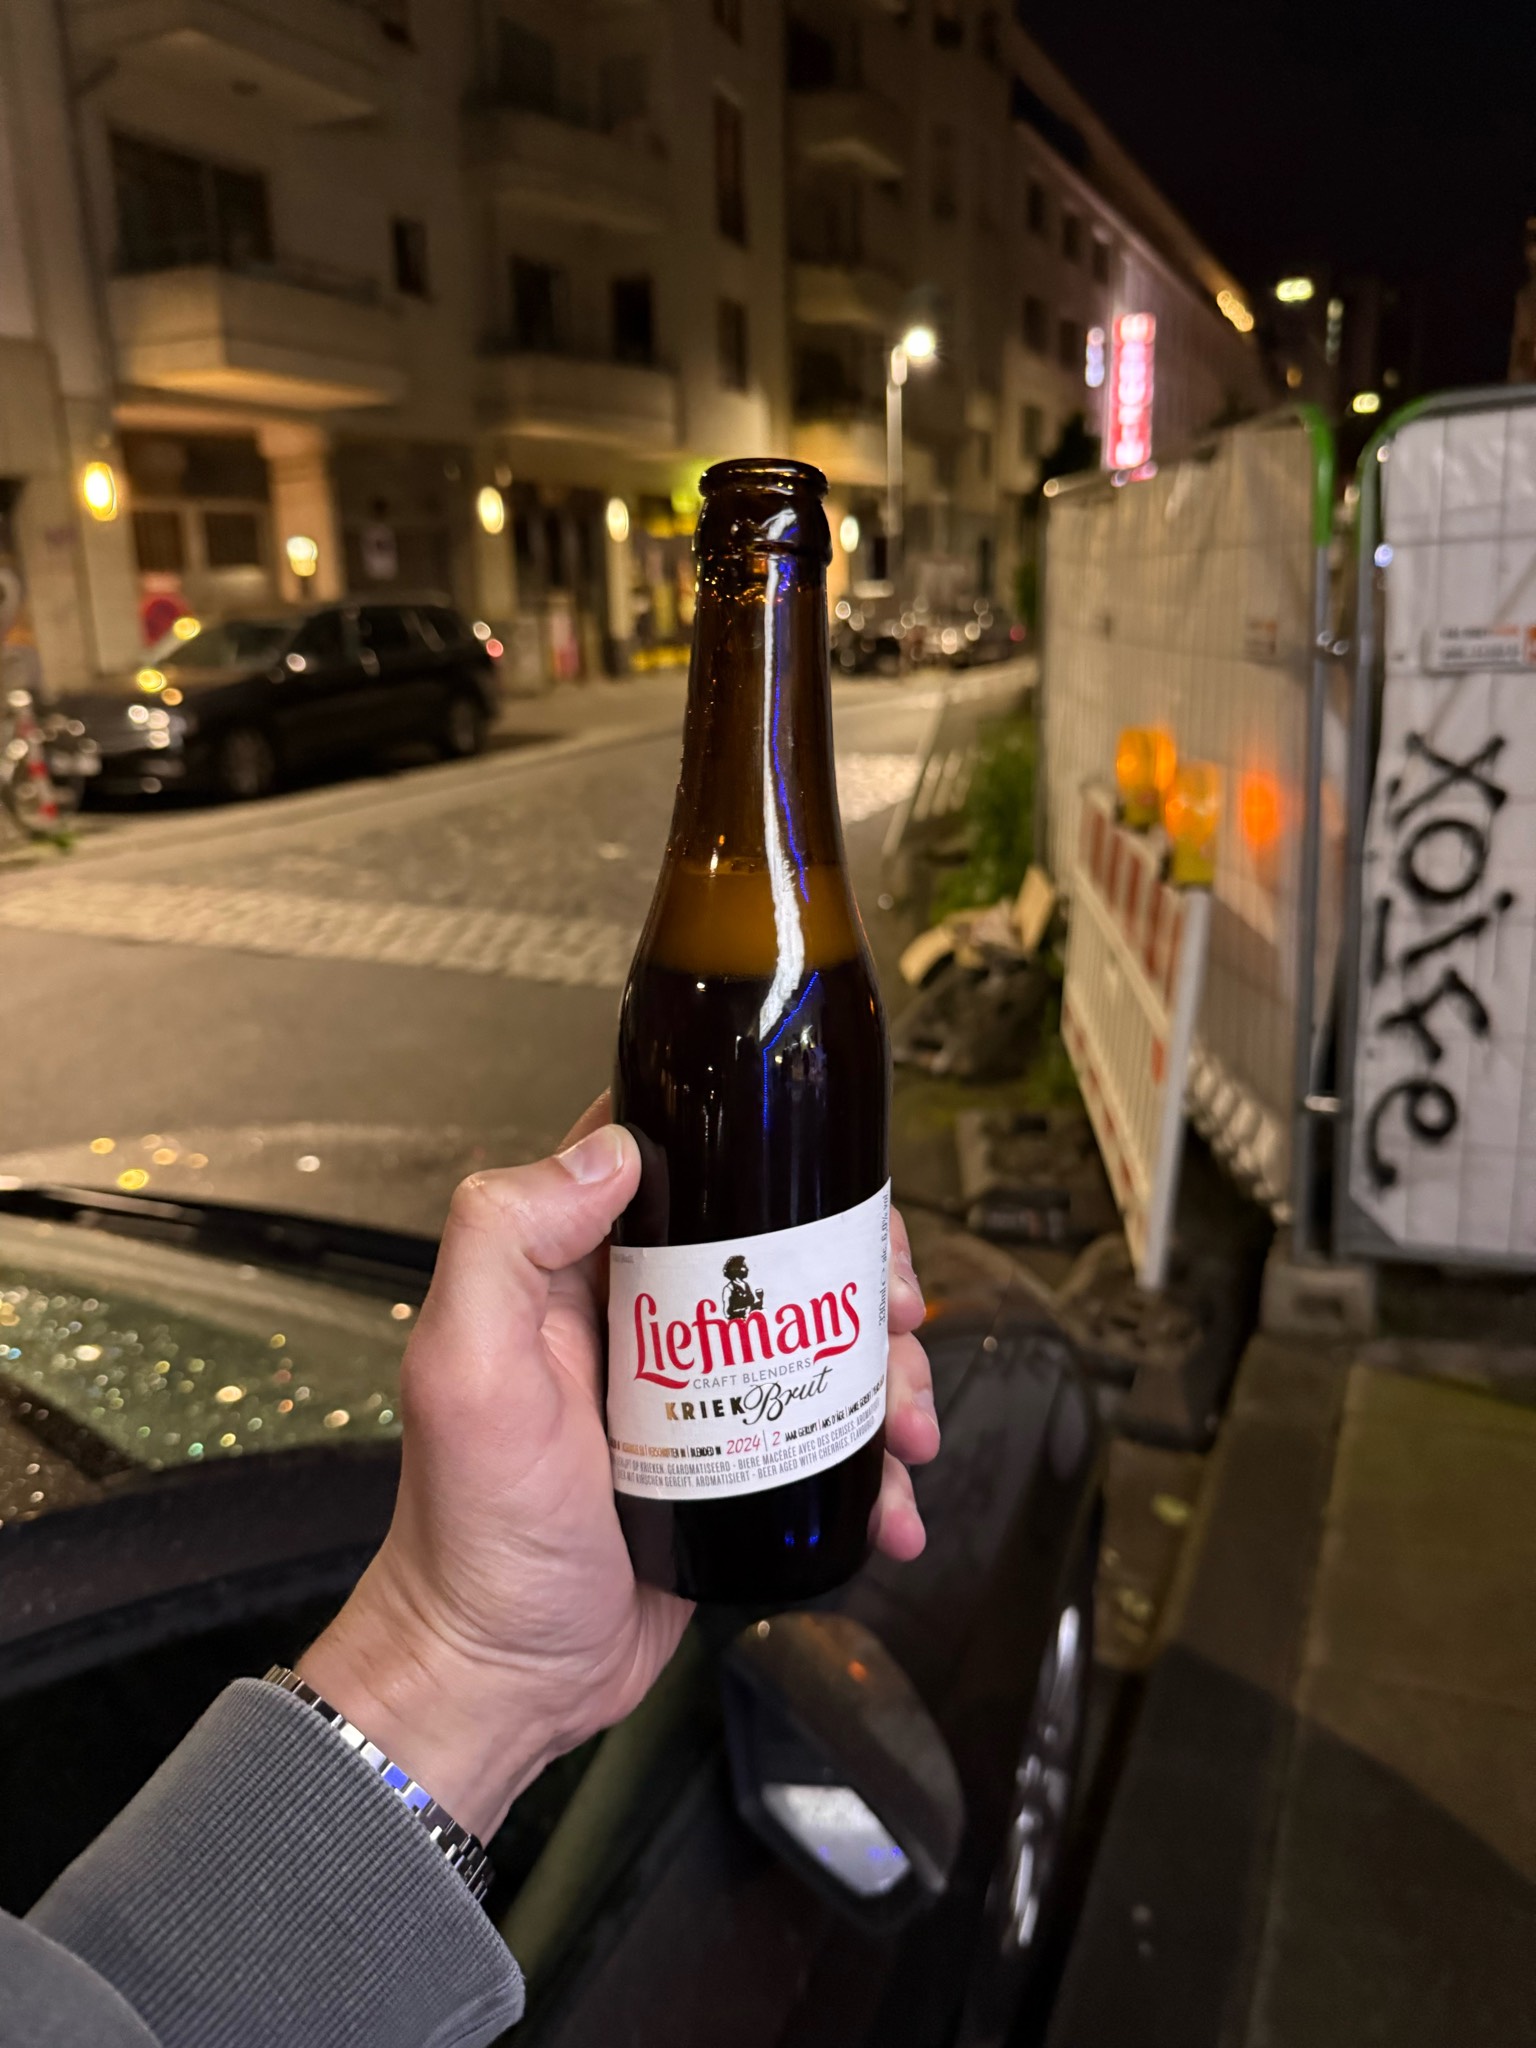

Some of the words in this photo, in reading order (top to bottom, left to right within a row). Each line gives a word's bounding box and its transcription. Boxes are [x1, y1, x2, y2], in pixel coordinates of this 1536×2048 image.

[634, 1282, 860, 1389] Liefmans
[693, 1375, 737, 1389] CRAFT
[743, 1357, 812, 1384] BLENDERS
[665, 1396, 745, 1421] KRIEK
[742, 1366, 833, 1425] Brut
[727, 1434, 760, 1455] 2024
[772, 1431, 780, 1446] 2
[799, 1439, 815, 1455] AVEC
[817, 1433, 830, 1447] DES
[696, 1470, 750, 1487] AROMATISIERT
[758, 1465, 777, 1479] BEER
[780, 1460, 798, 1474] AGED
[800, 1451, 817, 1467] WITH
